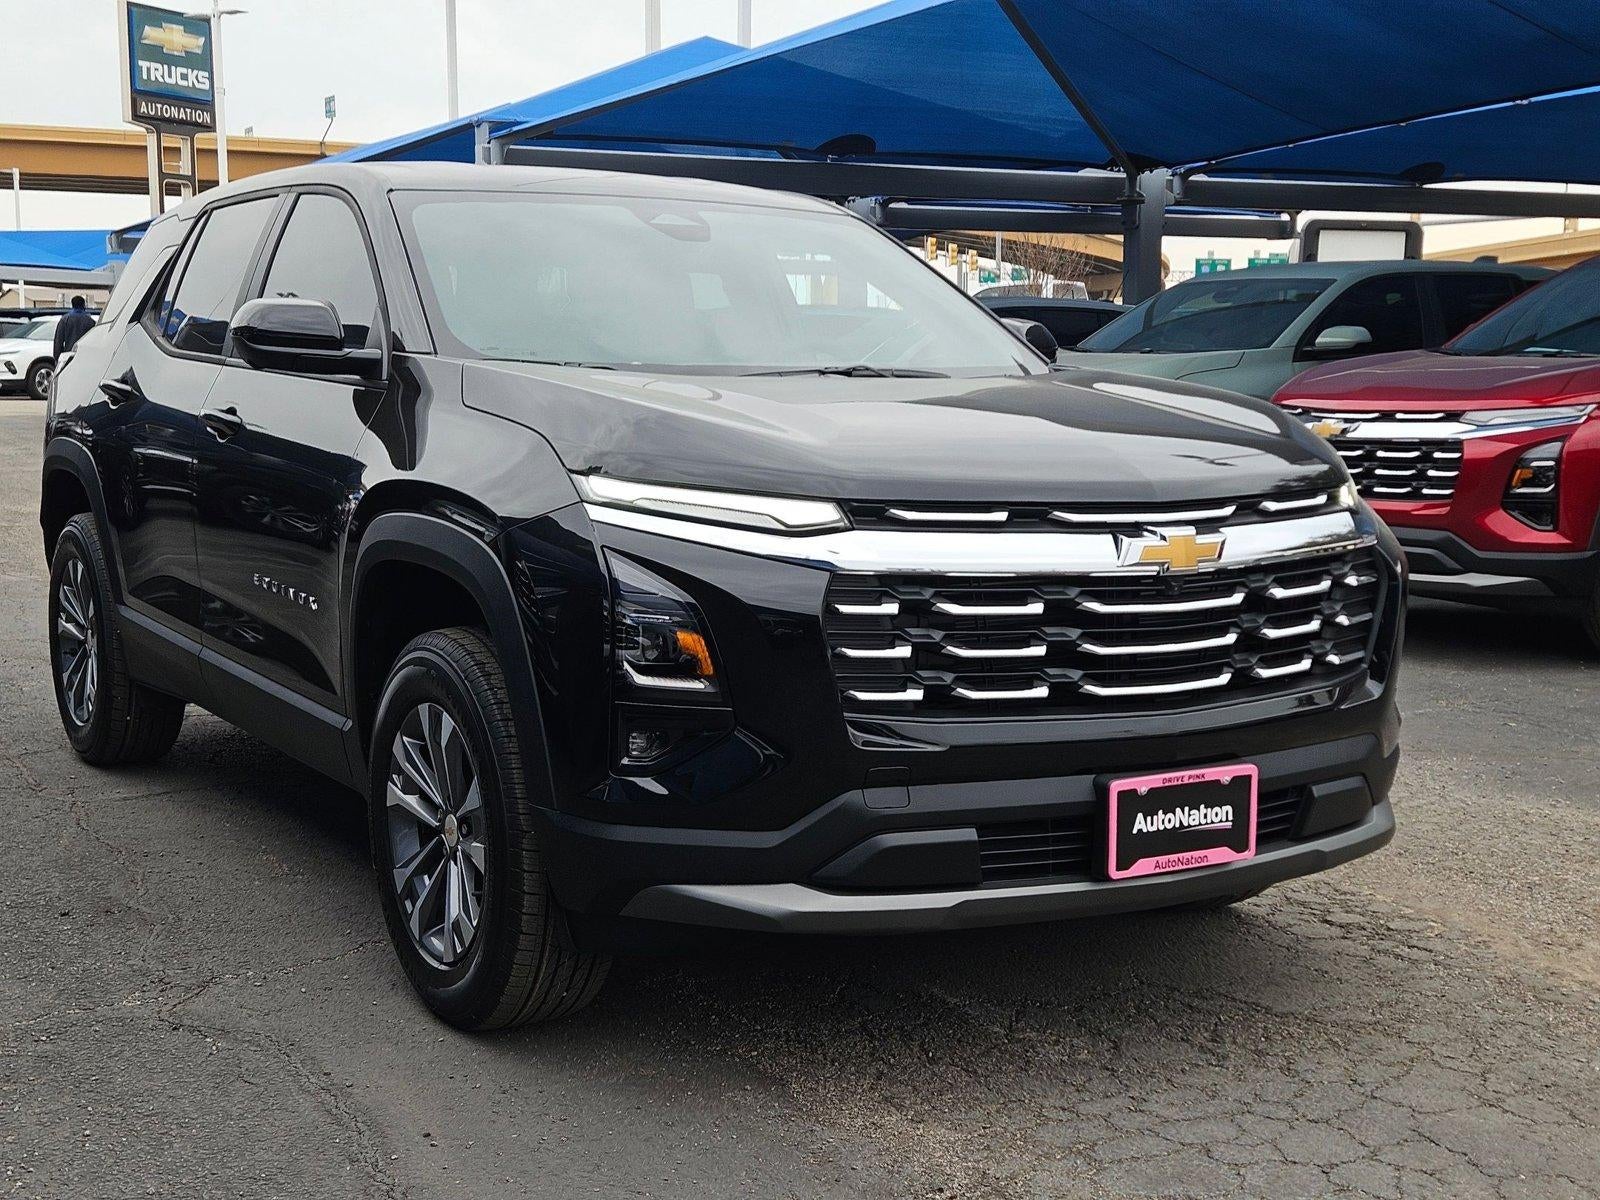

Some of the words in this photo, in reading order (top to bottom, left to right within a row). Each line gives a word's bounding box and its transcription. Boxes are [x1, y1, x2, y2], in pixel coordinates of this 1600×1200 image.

[138, 60, 210, 91] TRUCKS
[140, 101, 211, 124] AUTONATION
[1162, 775, 1185, 785] DRIVE
[1187, 773, 1206, 782] PINK
[1132, 804, 1234, 834] AutoNation
[1153, 854, 1209, 871] AutoNation
